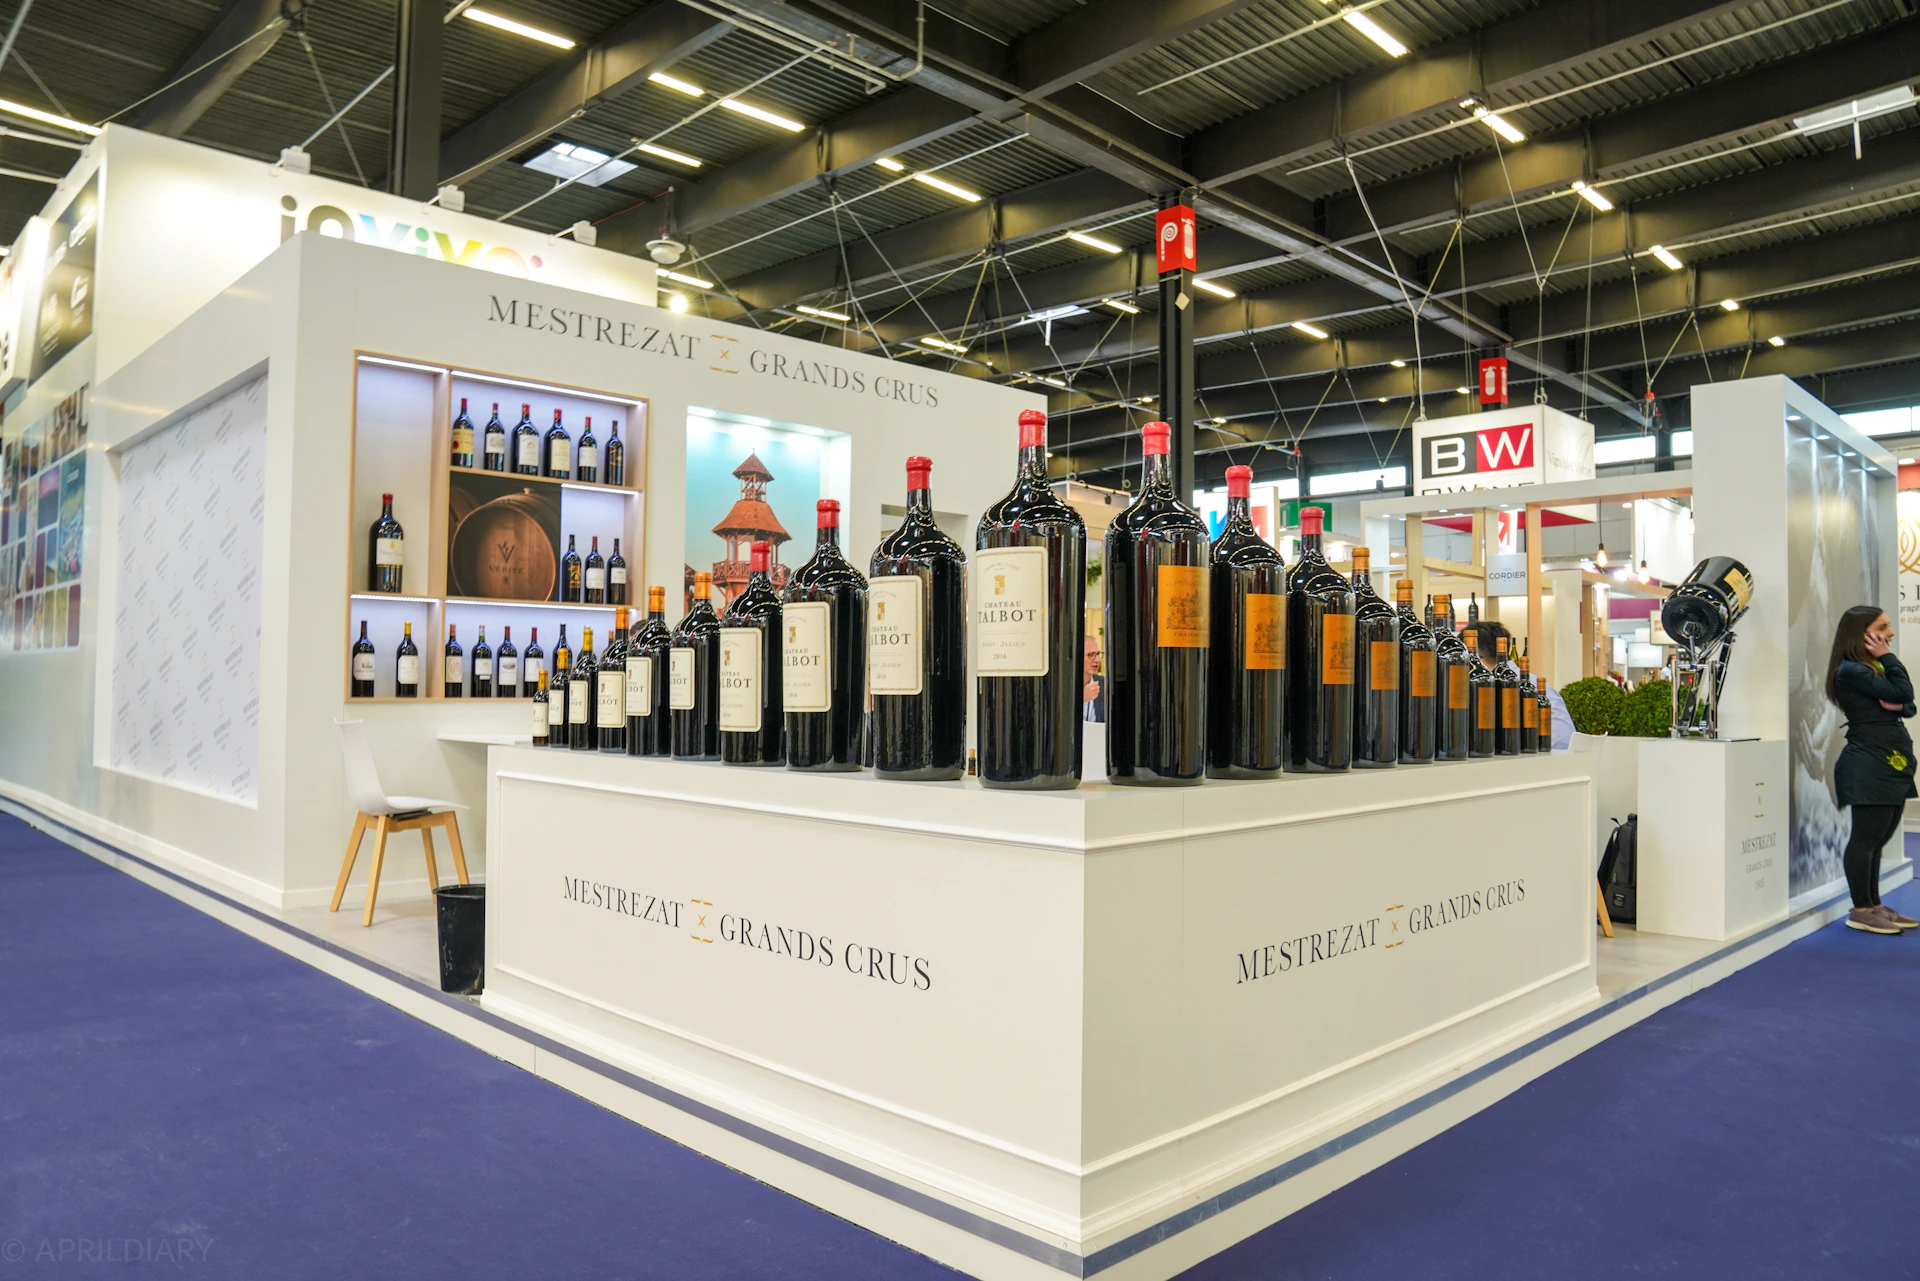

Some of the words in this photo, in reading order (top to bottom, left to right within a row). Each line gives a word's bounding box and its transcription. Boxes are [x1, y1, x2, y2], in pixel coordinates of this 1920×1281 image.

[488, 295, 700, 361] MESTREZAT
[749, 349, 866, 393] GRANDS
[874, 376, 940, 408] CRUS
[1488, 571, 1526, 580] CORDIER
[978, 609, 1037, 624] TALBOT
[1741, 832, 1777, 855] MESTREZAT
[563, 875, 684, 929] MESTREZAT
[720, 913, 834, 967] GRANDS
[844, 943, 932, 991] CRUS
[1236, 918, 1380, 985] MESTREZAT
[1408, 890, 1482, 935] GRANDS
[1486, 878, 1526, 911] CRUS
